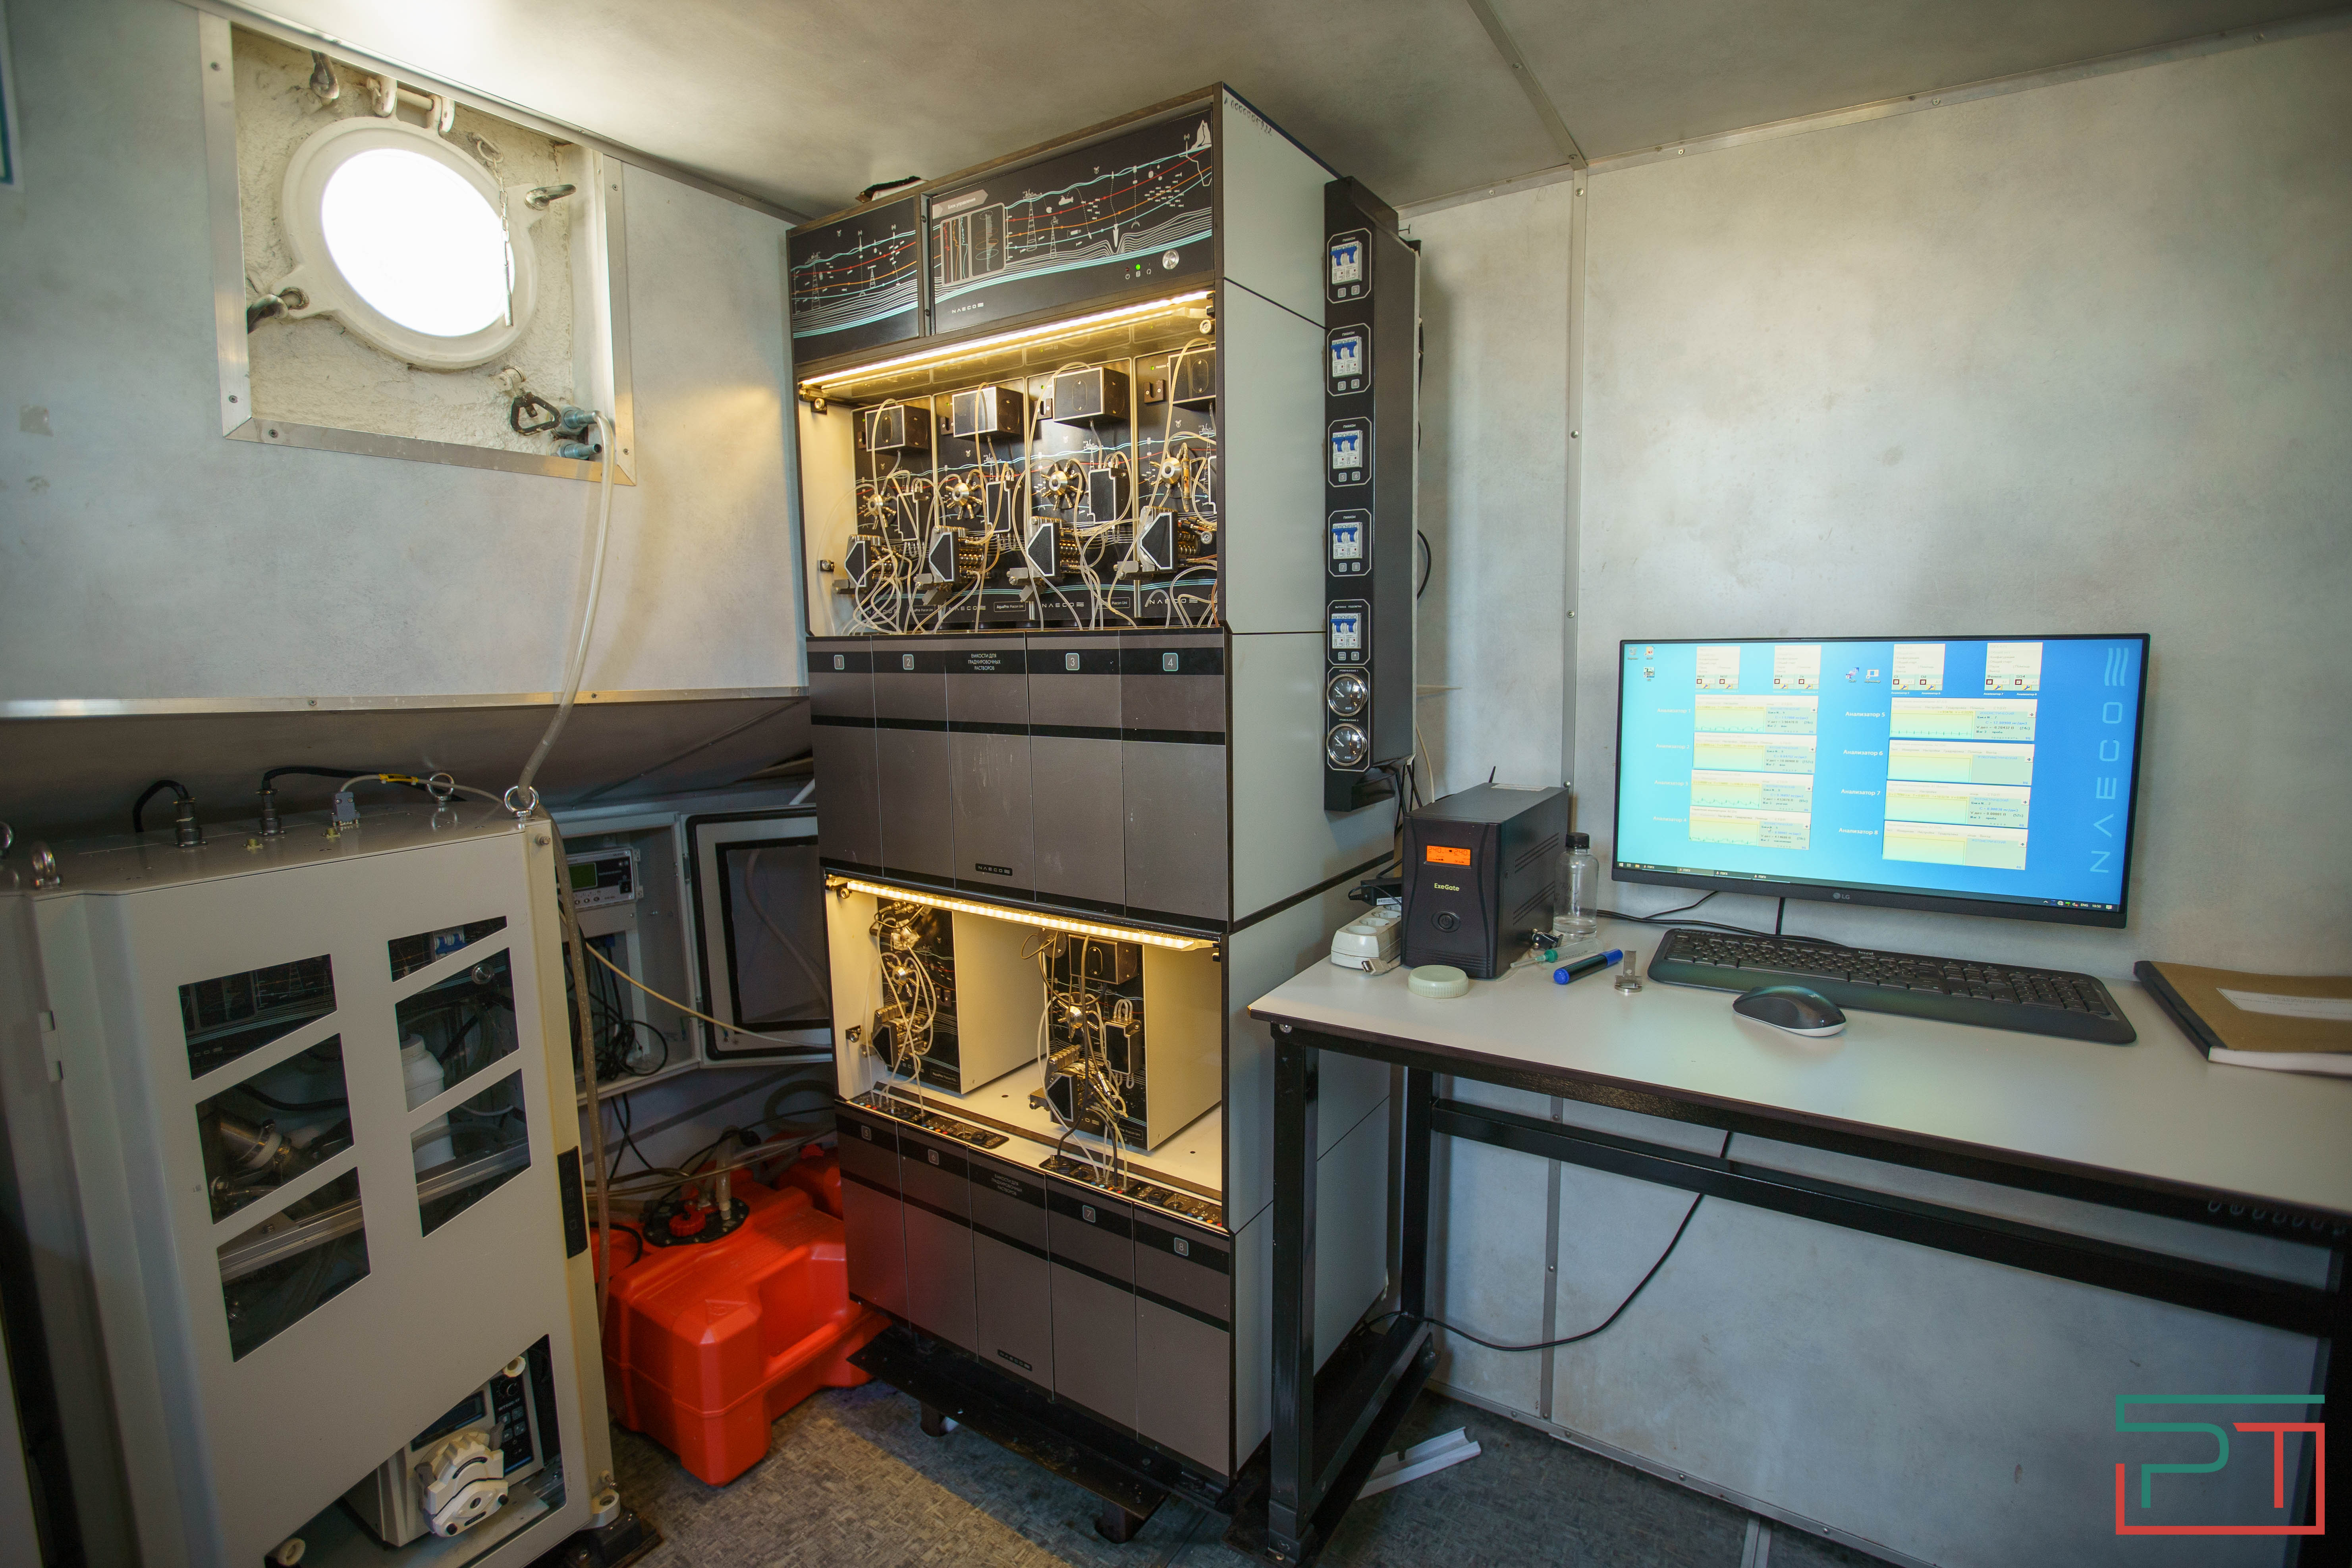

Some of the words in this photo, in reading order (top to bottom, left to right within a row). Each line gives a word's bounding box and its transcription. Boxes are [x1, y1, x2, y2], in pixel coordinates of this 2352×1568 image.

[907, 658, 911, 666] 2
[1070, 658, 1075, 666] 3
[1168, 658, 1173, 667] 4
[1434, 883, 1460, 891] ExeGate
[1179, 1243, 1184, 1251] 8
